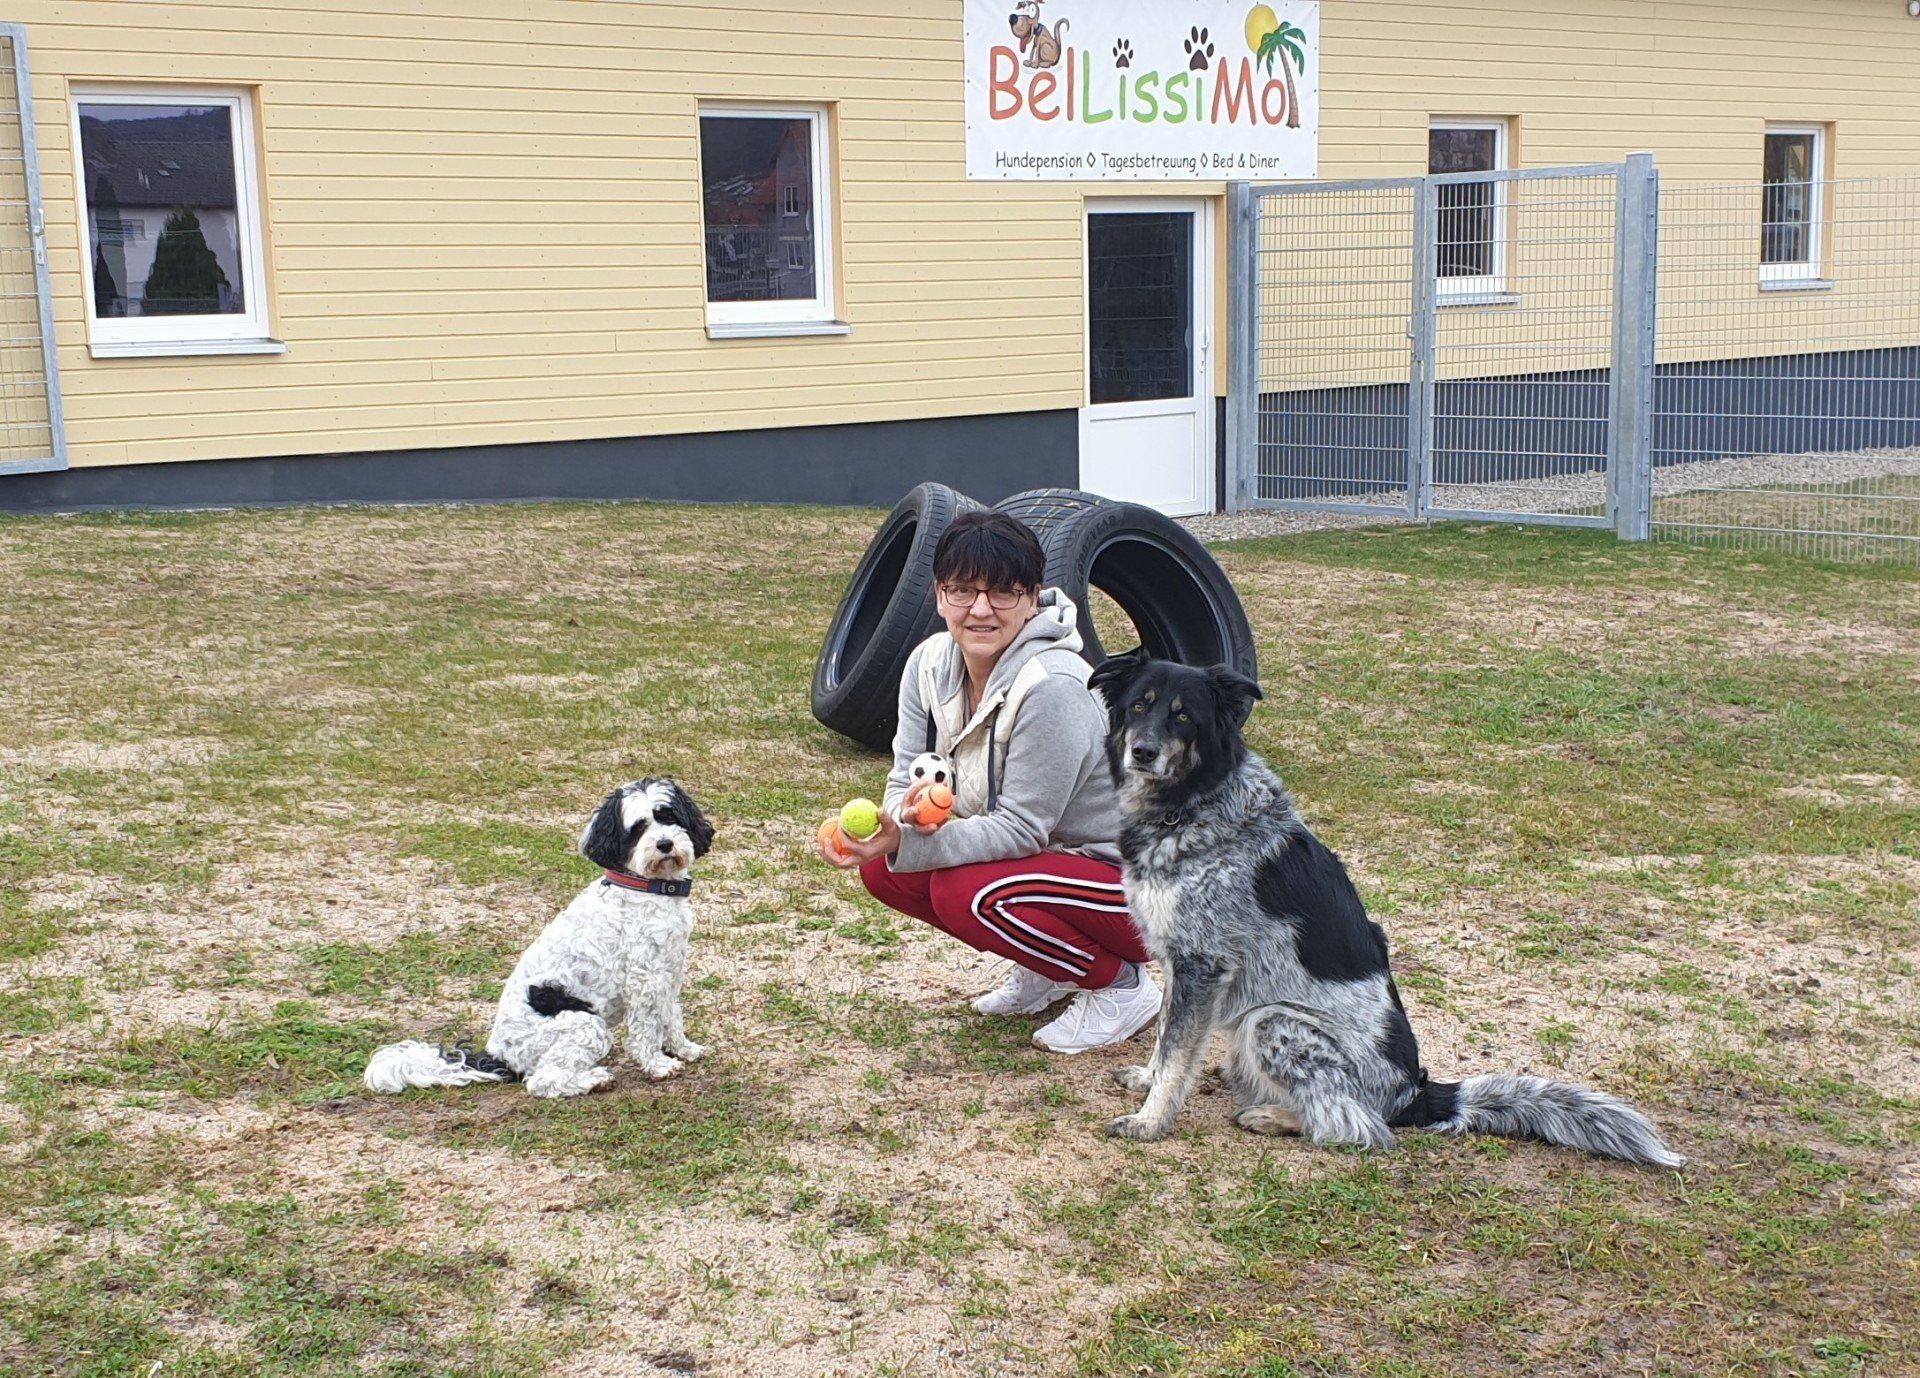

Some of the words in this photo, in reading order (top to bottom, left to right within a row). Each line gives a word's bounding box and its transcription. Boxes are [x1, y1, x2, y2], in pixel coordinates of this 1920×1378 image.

[989, 45, 1287, 126] BelLissiMo
[995, 151, 1083, 173] Hundepension
[1101, 152, 1197, 173] Tagesbetreuung
[1212, 153, 1234, 169] Bed
[1237, 153, 1245, 168] &
[1249, 153, 1280, 169] Diner
